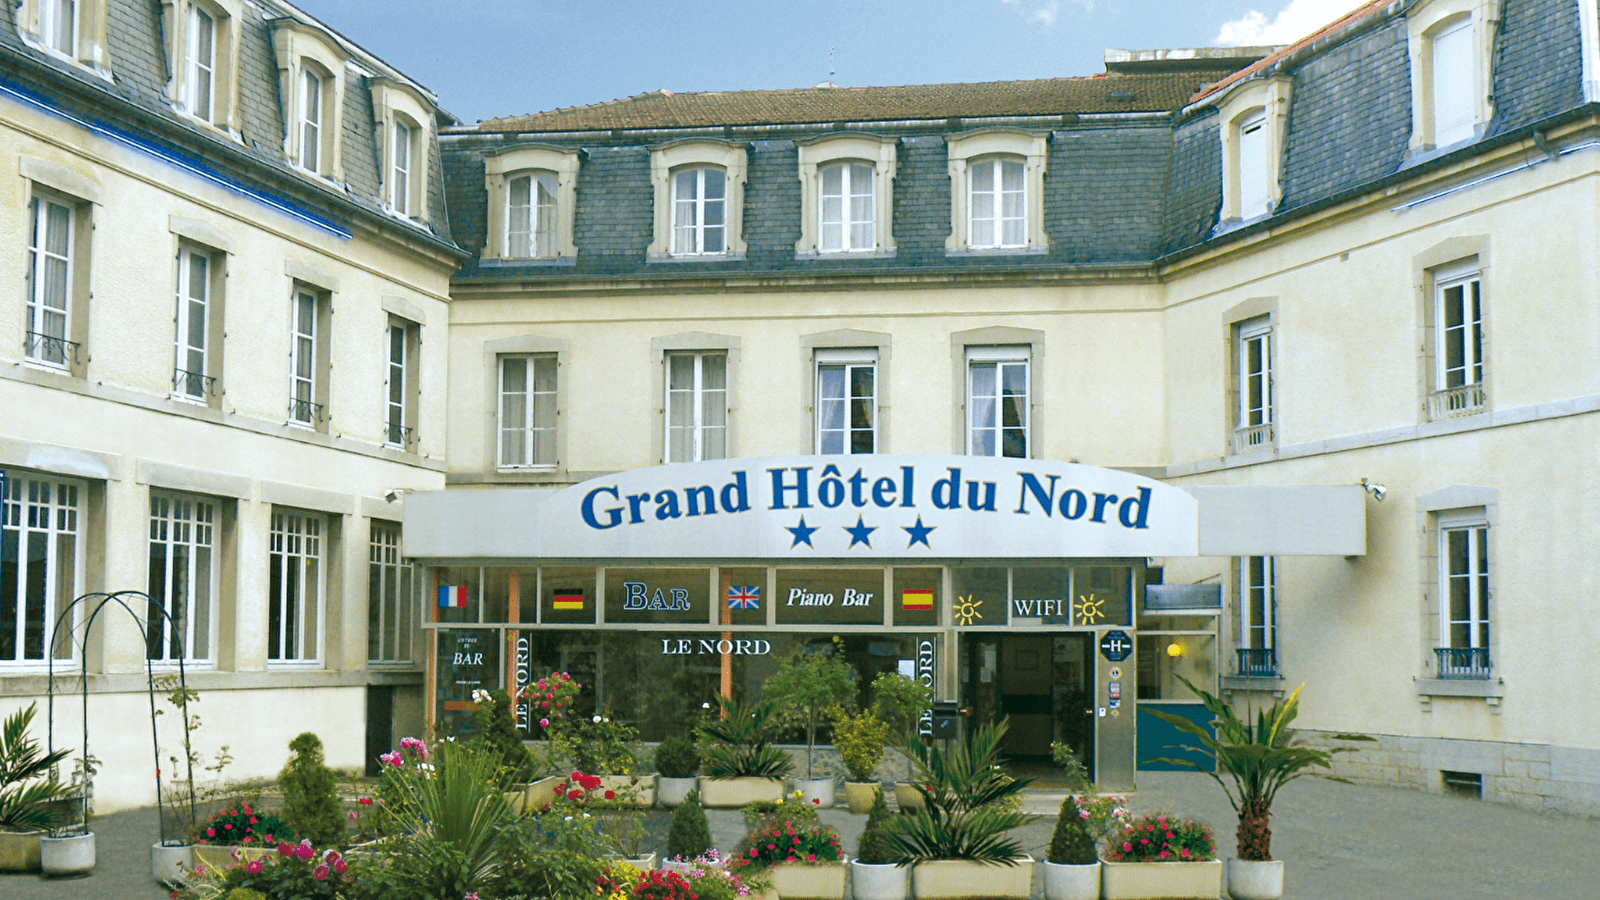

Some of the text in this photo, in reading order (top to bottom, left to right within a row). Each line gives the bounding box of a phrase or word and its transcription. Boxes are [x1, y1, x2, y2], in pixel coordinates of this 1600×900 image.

[580, 464, 1152, 530] Grand Hôtel du Nord
[786, 588, 874, 608] Piano Bar
[1013, 599, 1063, 616] WIFI
[661, 639, 771, 655] LE NORD
[1110, 639, 1121, 652] H
[453, 652, 483, 665] BAR
[920, 640, 932, 735] LE ORD
[515, 703, 527, 729] LE
